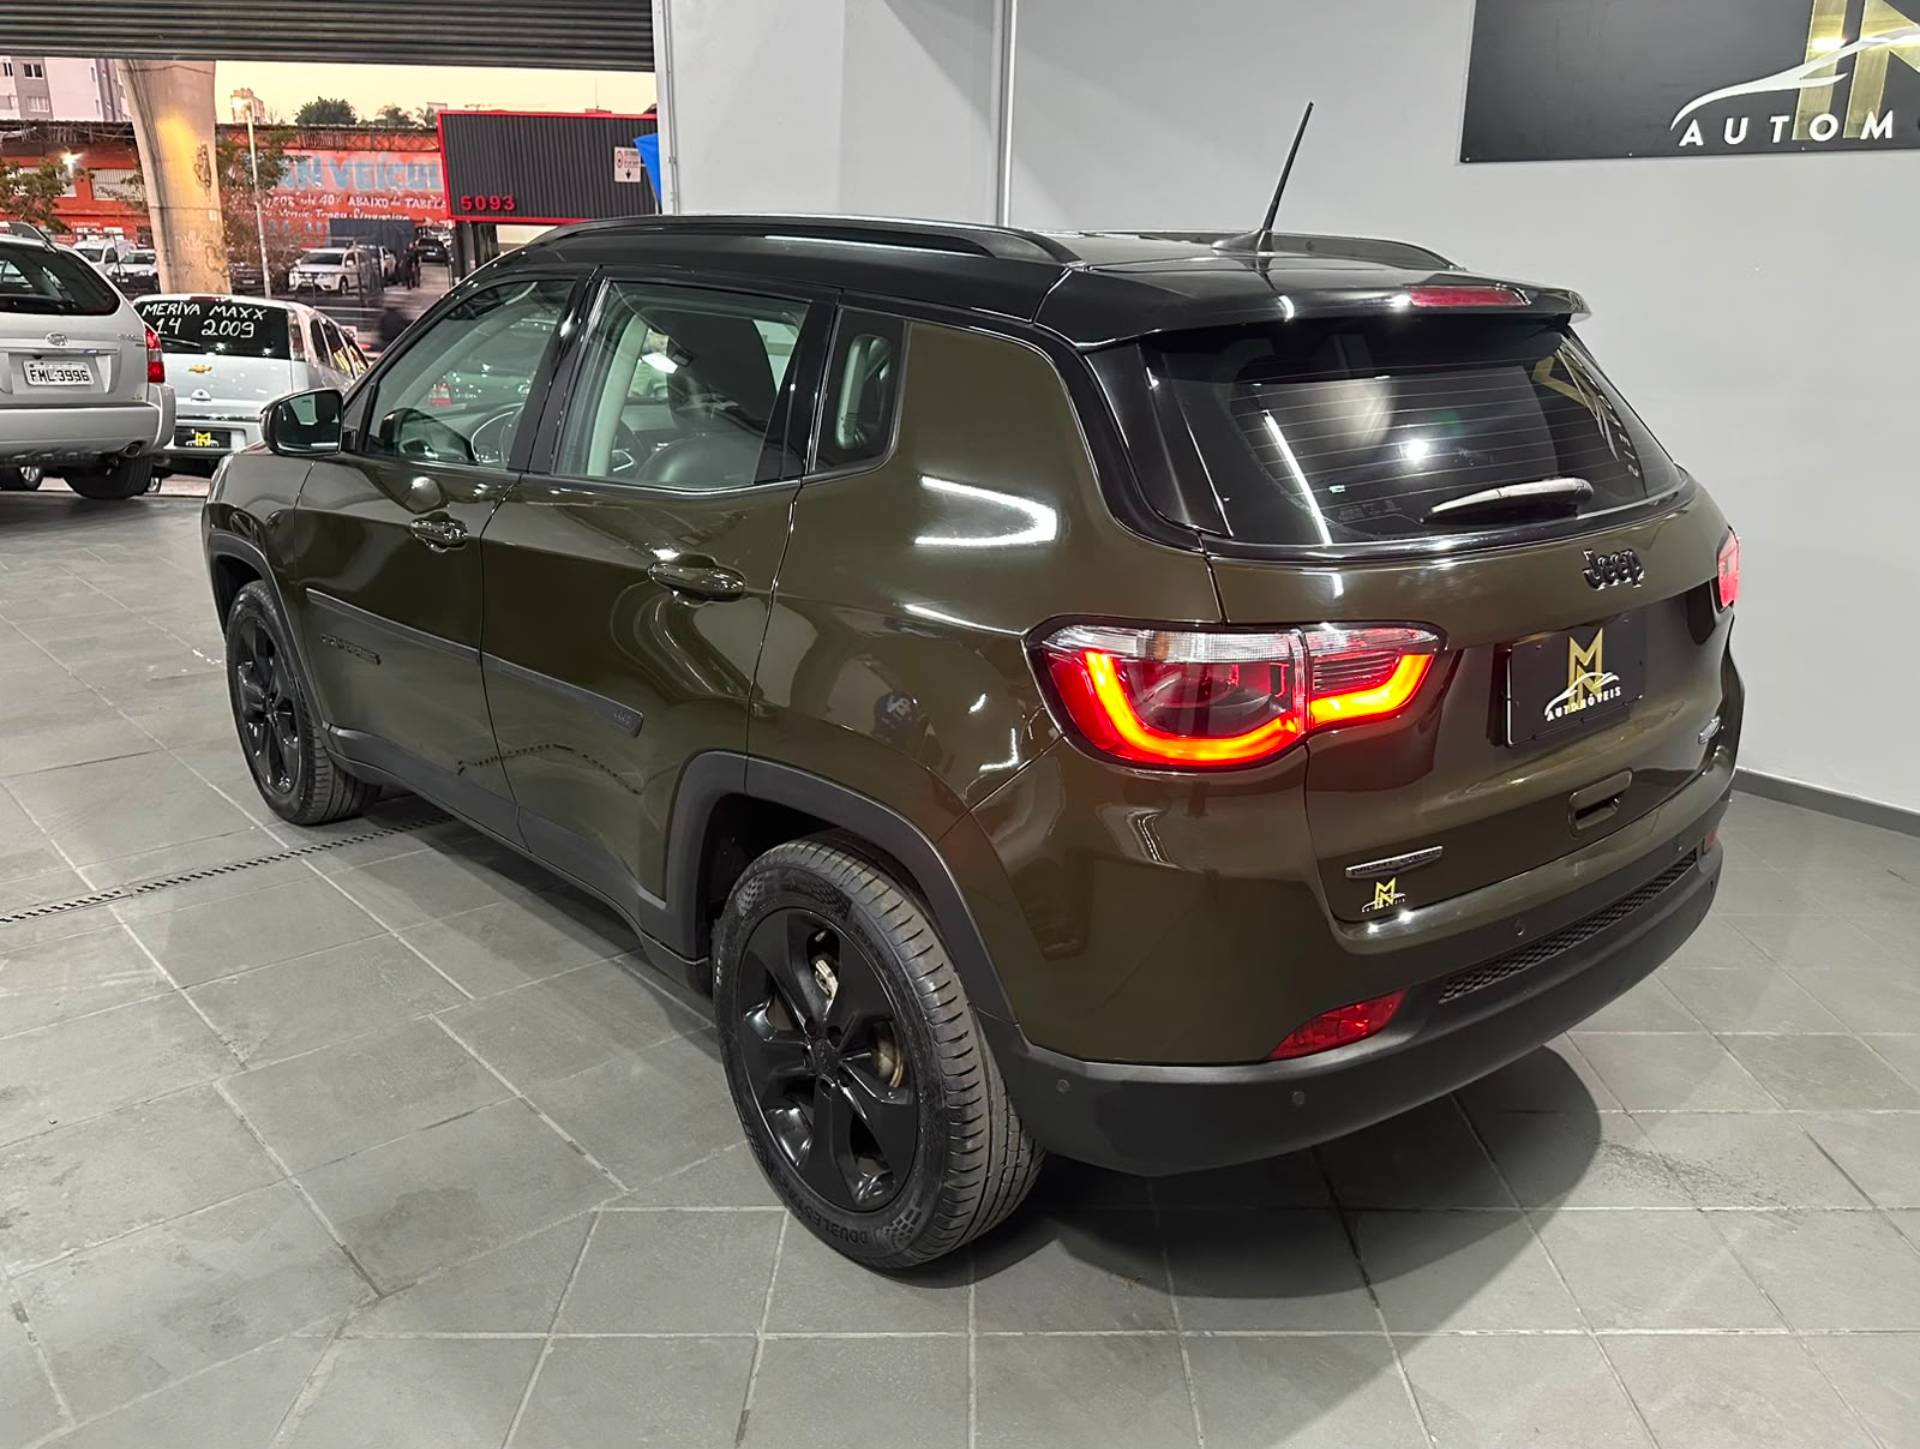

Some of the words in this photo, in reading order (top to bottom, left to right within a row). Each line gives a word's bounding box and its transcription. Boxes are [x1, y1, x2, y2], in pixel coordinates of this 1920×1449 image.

[348, 196, 389, 208] ABAIXO
[460, 195, 516, 211] 5093
[141, 302, 201, 316] MERIVA
[209, 305, 268, 320] MAXX
[156, 317, 181, 335] 1.4
[201, 319, 255, 338] 2009
[1582, 549, 1645, 590] Jeep
